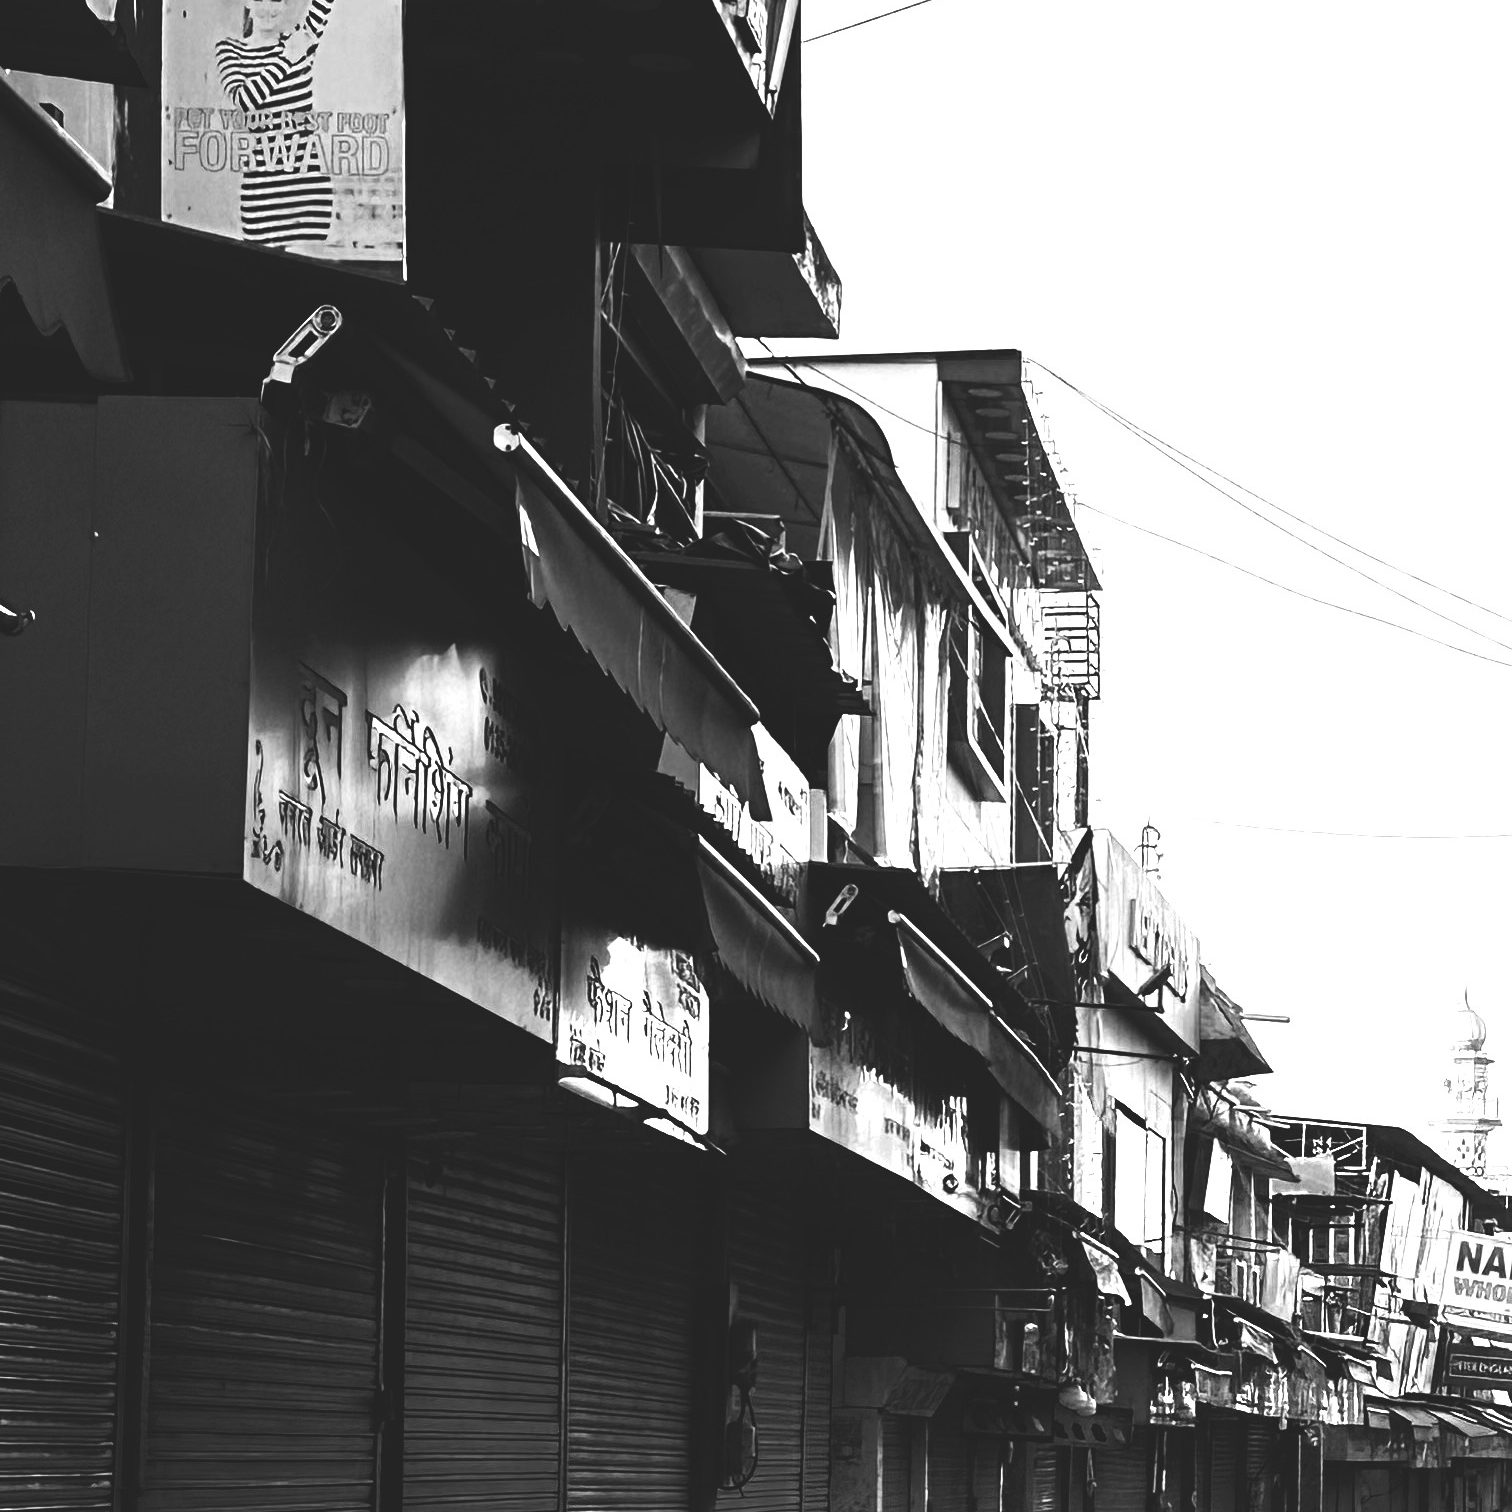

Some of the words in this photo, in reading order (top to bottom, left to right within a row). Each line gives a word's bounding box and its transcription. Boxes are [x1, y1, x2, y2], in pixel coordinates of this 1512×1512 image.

[174, 107, 214, 130] PUT
[219, 107, 274, 130] YOUR
[337, 112, 389, 135] FOOT
[174, 129, 389, 176] FORWARD
